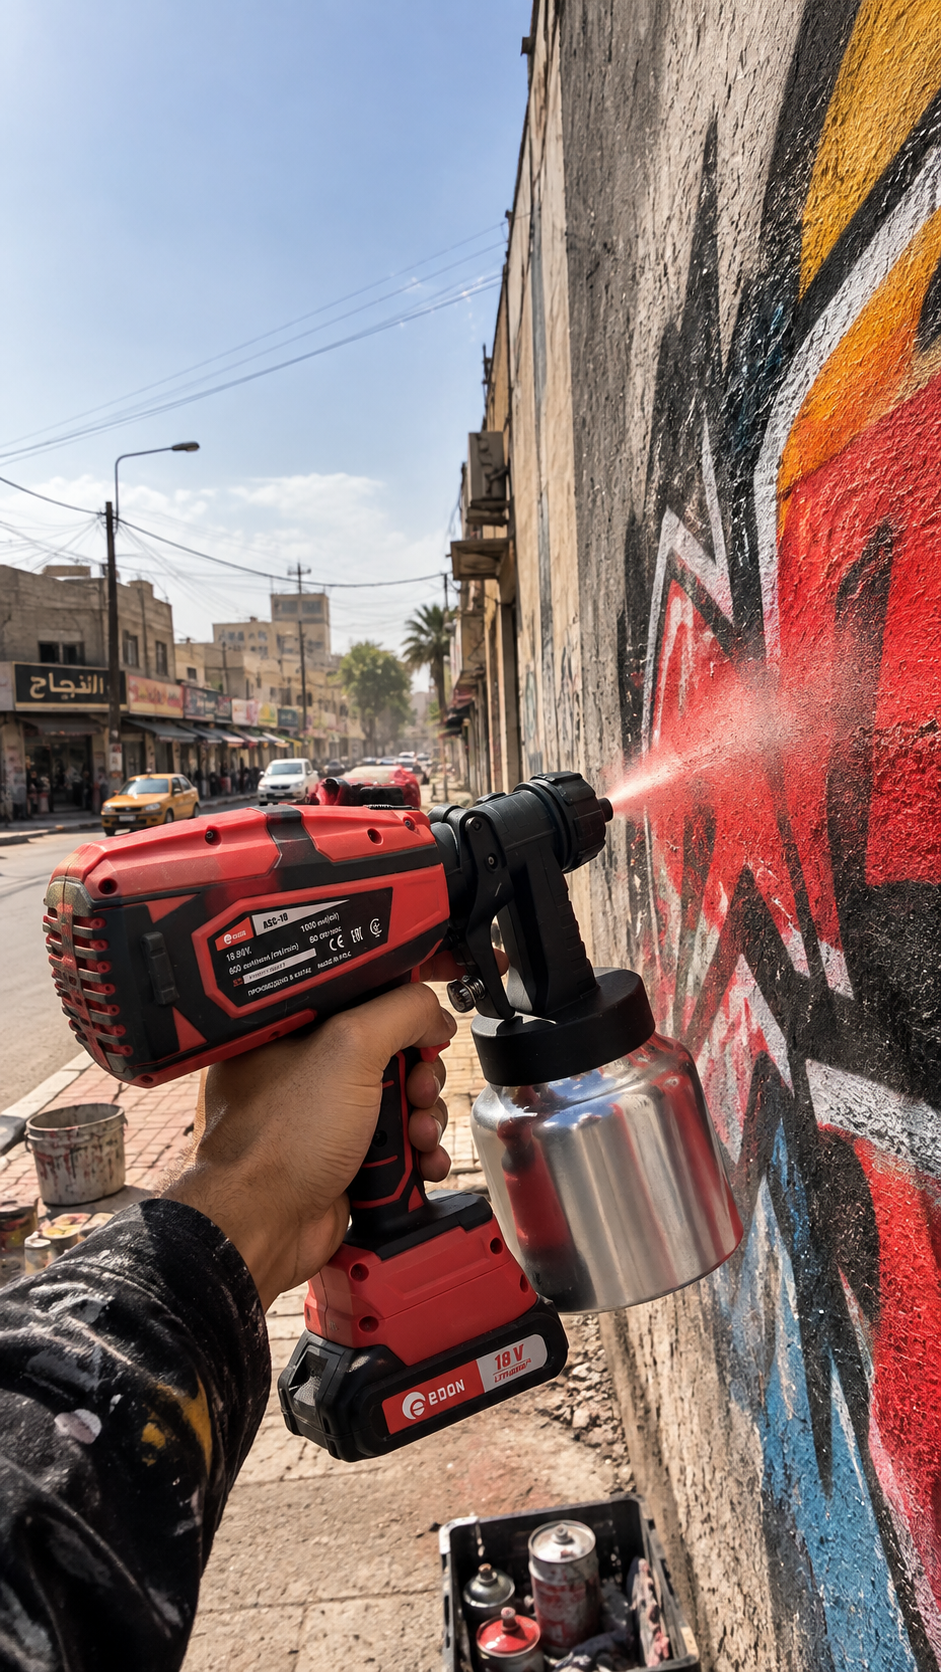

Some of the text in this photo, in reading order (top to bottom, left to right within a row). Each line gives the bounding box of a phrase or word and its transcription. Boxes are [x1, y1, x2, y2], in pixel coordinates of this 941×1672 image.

[263, 912, 288, 929] ASC-18
[495, 1343, 524, 1370] 18 V
